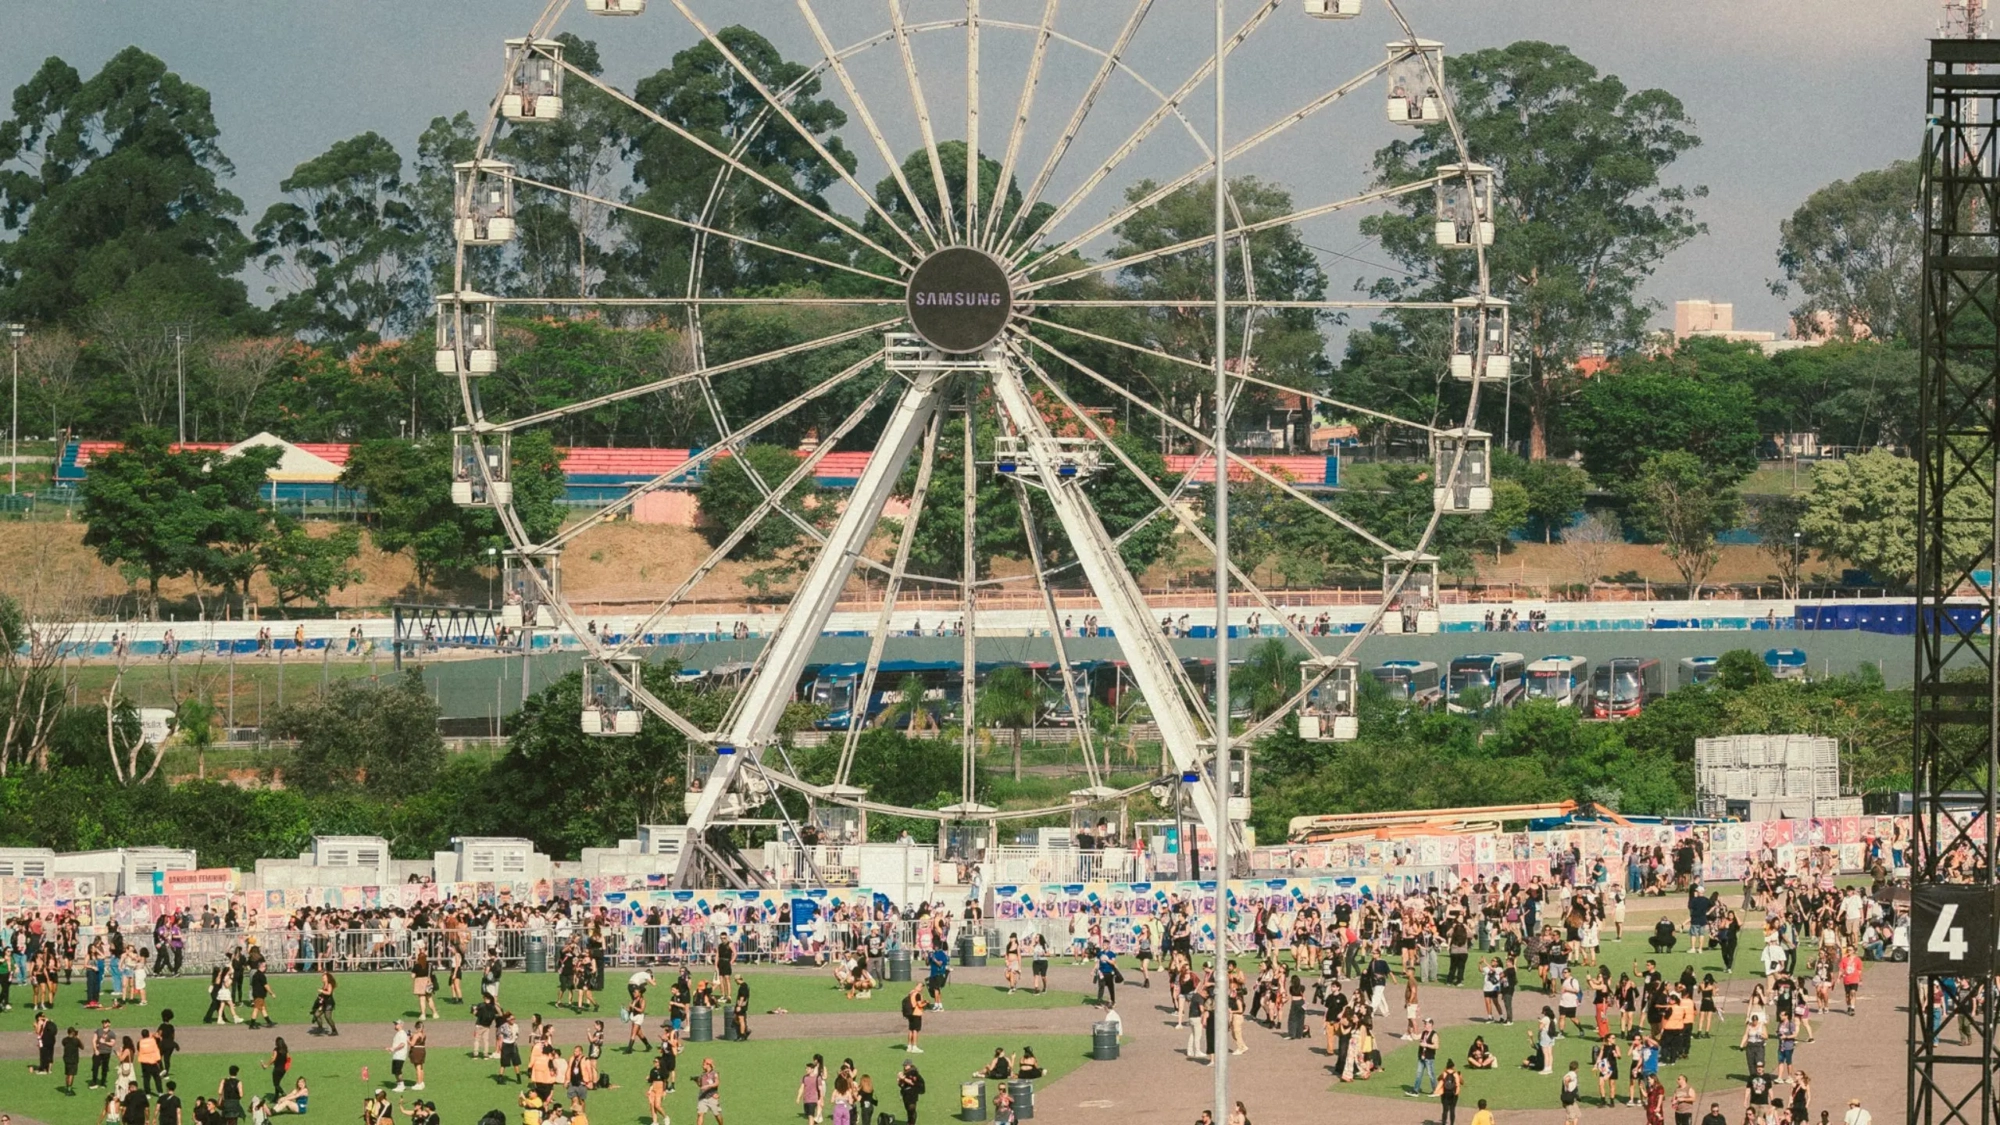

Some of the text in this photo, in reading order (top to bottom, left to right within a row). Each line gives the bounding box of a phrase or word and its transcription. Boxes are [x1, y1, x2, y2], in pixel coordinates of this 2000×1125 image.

[915, 292, 1001, 306] SAMSUNG
[169, 874, 227, 883] BANHEIRO FEMININO
[1927, 903, 1969, 960] 4
